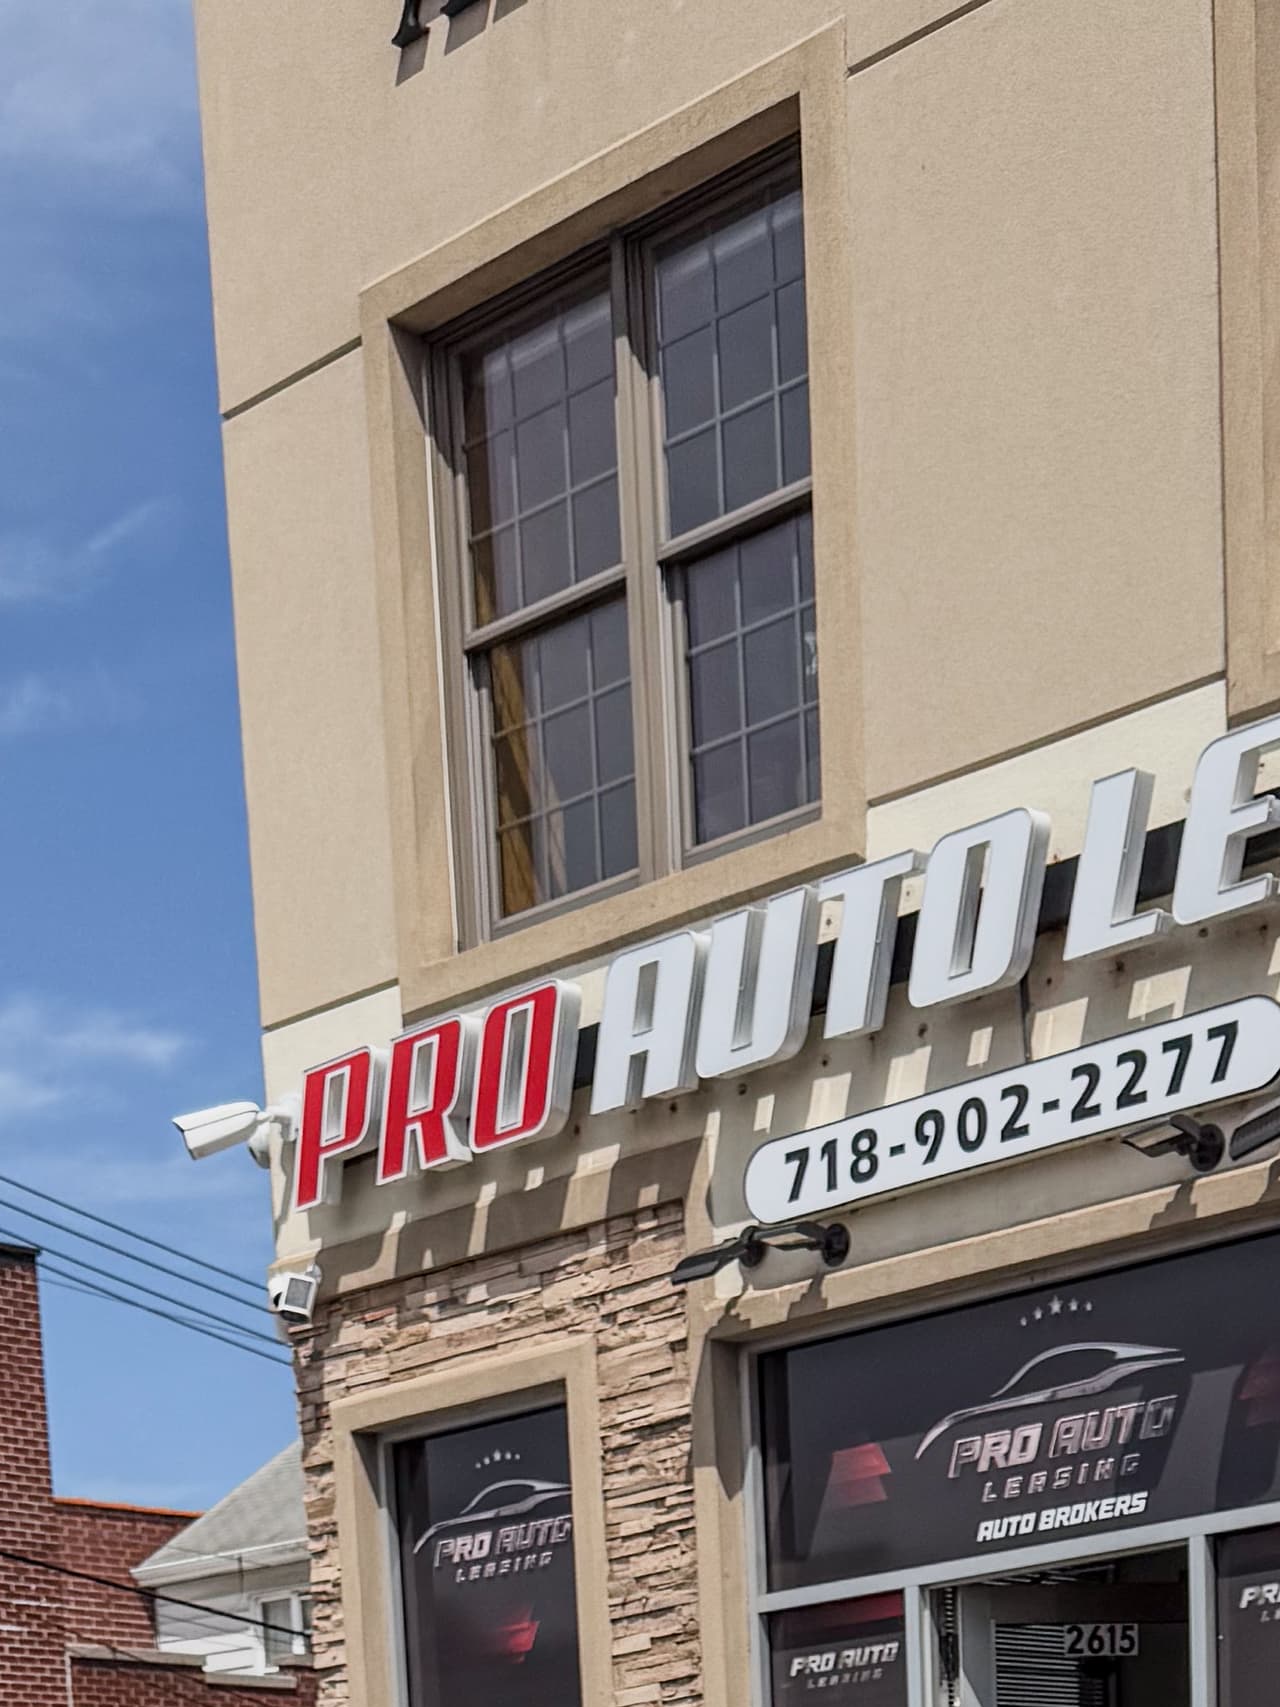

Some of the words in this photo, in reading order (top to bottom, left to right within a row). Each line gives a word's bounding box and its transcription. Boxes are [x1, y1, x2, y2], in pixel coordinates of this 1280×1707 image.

[296, 978, 582, 1211] PRO
[591, 807, 1051, 1115] AUTO
[783, 1019, 1241, 1203] 718-902-2277
[947, 1422, 1044, 1480] PRO
[1049, 1395, 1178, 1458] AUTO
[982, 1453, 1142, 1504] LEASING
[433, 1531, 493, 1568] PRO
[494, 1514, 573, 1555] AUTO
[976, 1512, 1035, 1543] AUTO
[1038, 1492, 1149, 1532] BROKERS
[456, 1552, 553, 1583] LEASING
[789, 1651, 837, 1677] PRO
[837, 1641, 900, 1669] AUTO
[1065, 1625, 1136, 1656] 2615
